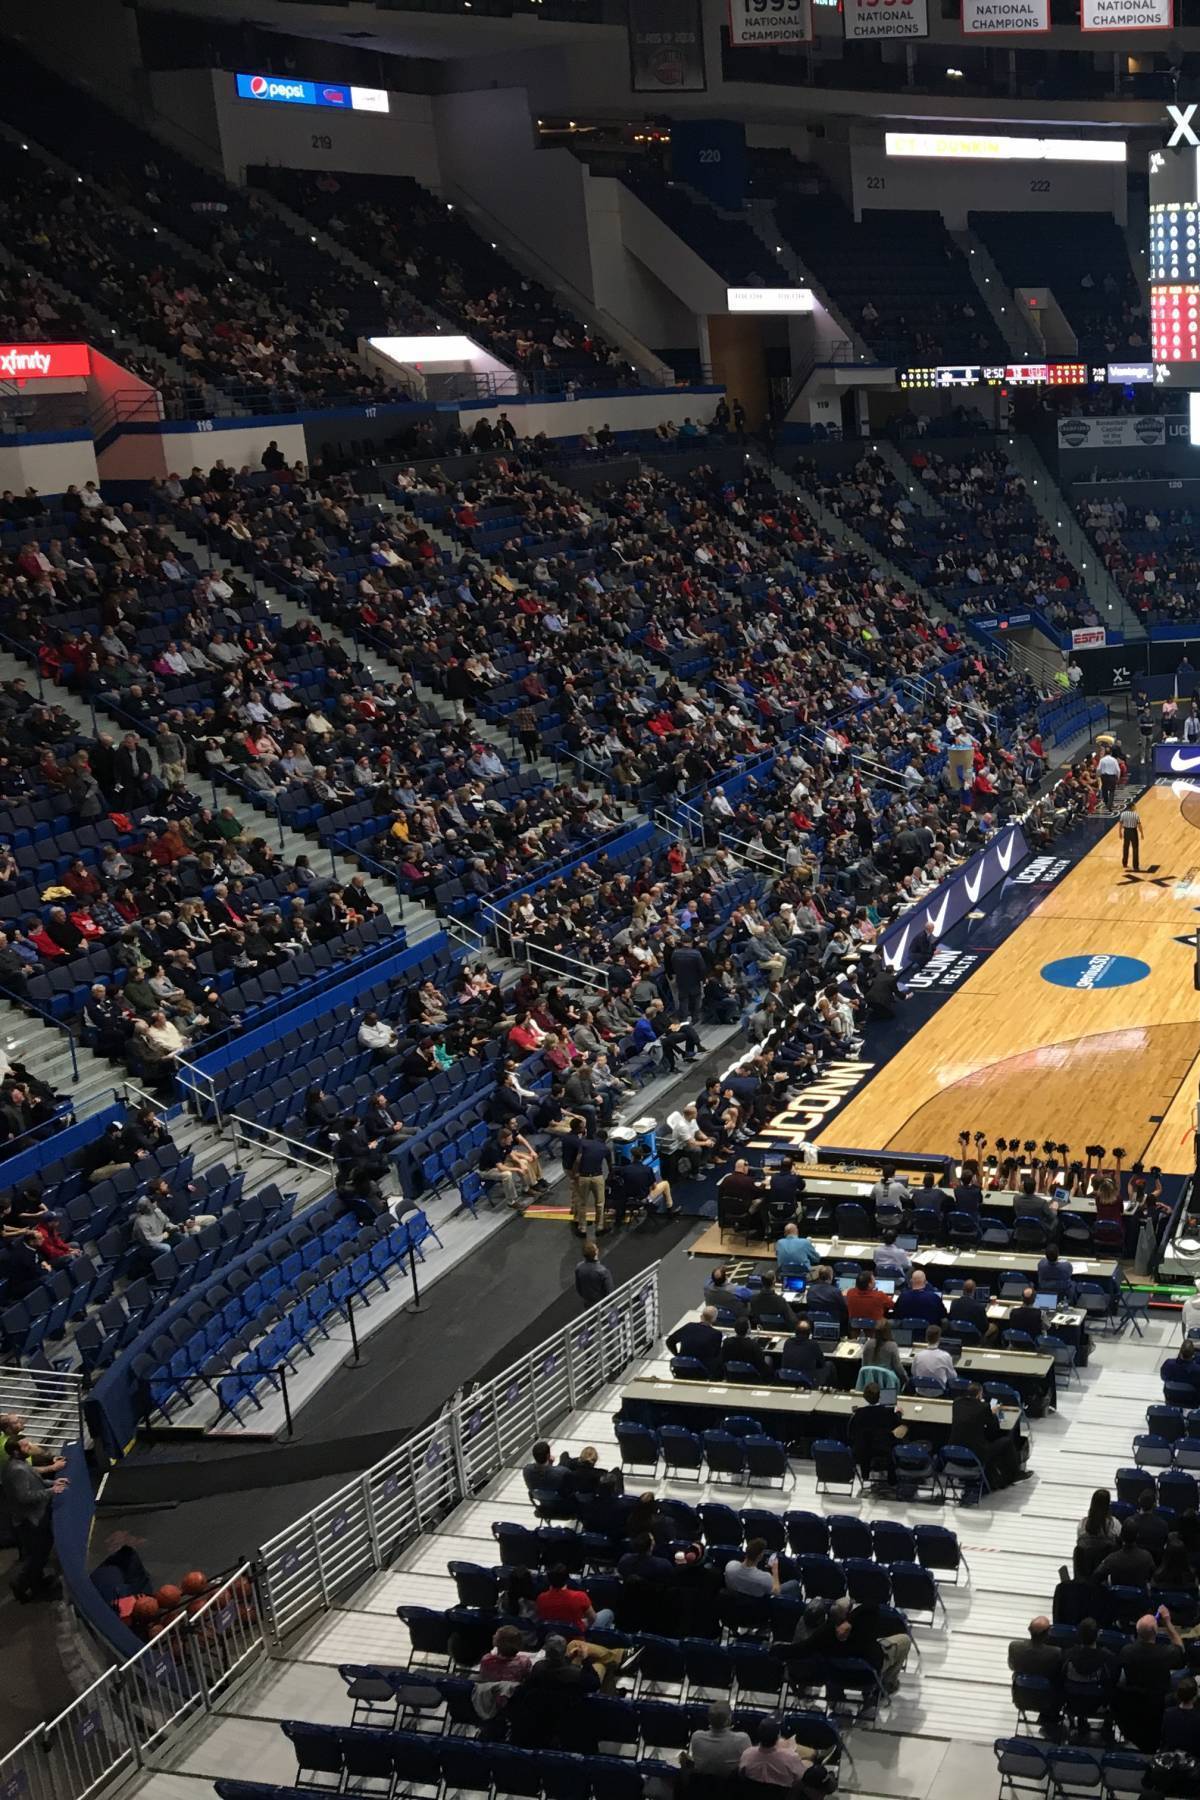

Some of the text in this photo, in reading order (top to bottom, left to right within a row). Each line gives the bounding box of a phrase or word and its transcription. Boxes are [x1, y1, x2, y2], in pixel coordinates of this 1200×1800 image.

[976, 5, 1034, 15] NATIONAL
[1097, 0, 1156, 10] NATIONAL
[745, 16, 799, 26] NATIONAL
[858, 11, 914, 21] NATIONAL
[1092, 14, 1161, 25] CHAMPIONS
[972, 18, 1039, 29] CHAMPIONS
[741, 29, 805, 41] CHAMPIONS
[854, 24, 919, 36] CHAMPIONS
[269, 83, 305, 99] pepsi
[311, 135, 332, 149] 219
[699, 149, 721, 162] 220
[866, 177, 886, 189] 221
[1030, 180, 1051, 192] 222
[0, 349, 51, 376] xfinity
[984, 369, 1004, 378] 12:50
[196, 420, 214, 432] 116
[1073, 631, 1104, 645] ESPN
[1113, 667, 1130, 682] XL
[1013, 855, 1057, 884] UCONN
[1041, 859, 1072, 883] HEALTH
[905, 950, 962, 988] UCONN
[939, 954, 978, 985] HEALTH
